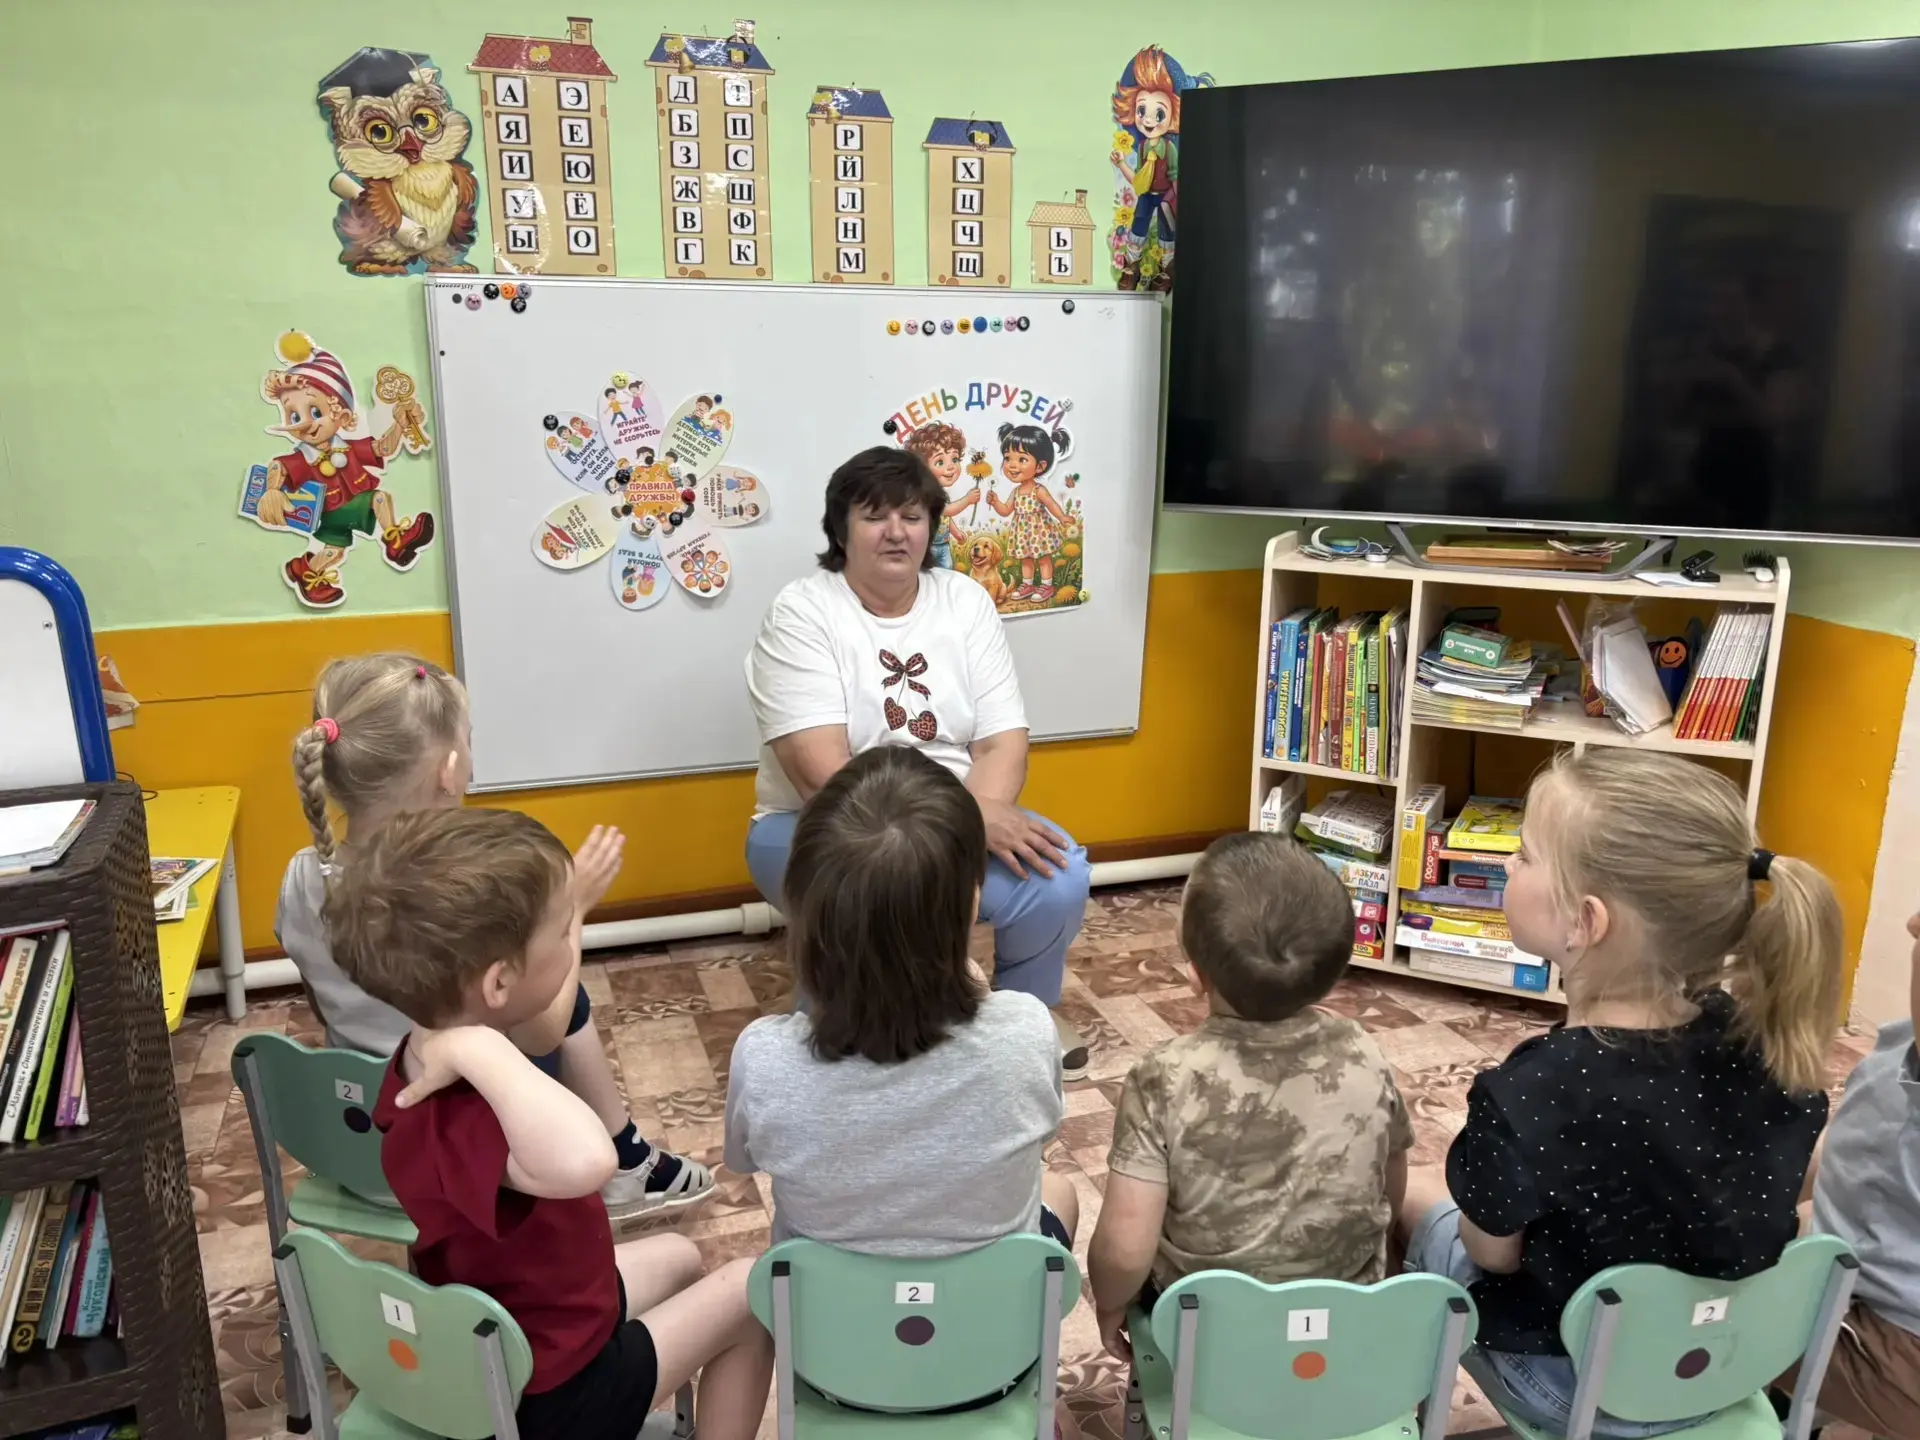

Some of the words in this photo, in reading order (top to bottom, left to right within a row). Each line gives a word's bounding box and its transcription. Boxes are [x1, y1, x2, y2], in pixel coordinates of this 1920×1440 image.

[566, 86, 583, 107] Э
[673, 81, 690, 103] Д
[504, 120, 521, 140] Я
[678, 114, 693, 132] Б
[731, 117, 747, 136] П
[679, 146, 693, 164] З
[507, 155, 525, 174] И
[566, 160, 593, 179] Ю
[842, 155, 857, 178] Й
[675, 180, 699, 199] Ж
[730, 182, 753, 201] Ш
[573, 192, 589, 215] Ё
[841, 192, 857, 209] Л
[961, 194, 975, 212] Ц
[733, 212, 752, 229] Ф
[511, 230, 533, 249] Ы
[961, 225, 974, 243] Ч
[1056, 231, 1068, 248] Ь
[683, 243, 697, 260] Г
[958, 257, 978, 276] Щ
[1054, 256, 1069, 273] Ъ
[890, 388, 958, 444] ДЕНЬ
[594, 445, 610, 462] ДЕЛА
[629, 482, 674, 491] ПРАВИЛА
[629, 493, 676, 503] ДРУЖБЫ
[1276, 671, 1290, 739] АРИФМЕТИКА
[1368, 695, 1376, 722] ЗНАТЬ
[1354, 867, 1386, 882] АЗБУКА
[1358, 878, 1380, 889] ПАЗЛ
[344, 1085, 352, 1099] 2
[85, 1247, 111, 1323] Чуковский
[908, 1288, 920, 1302] 2
[393, 1304, 401, 1321] 1
[1703, 1307, 1715, 1322] 2
[1304, 1317, 1311, 1332] 1
[18, 1328, 31, 1347] 2
